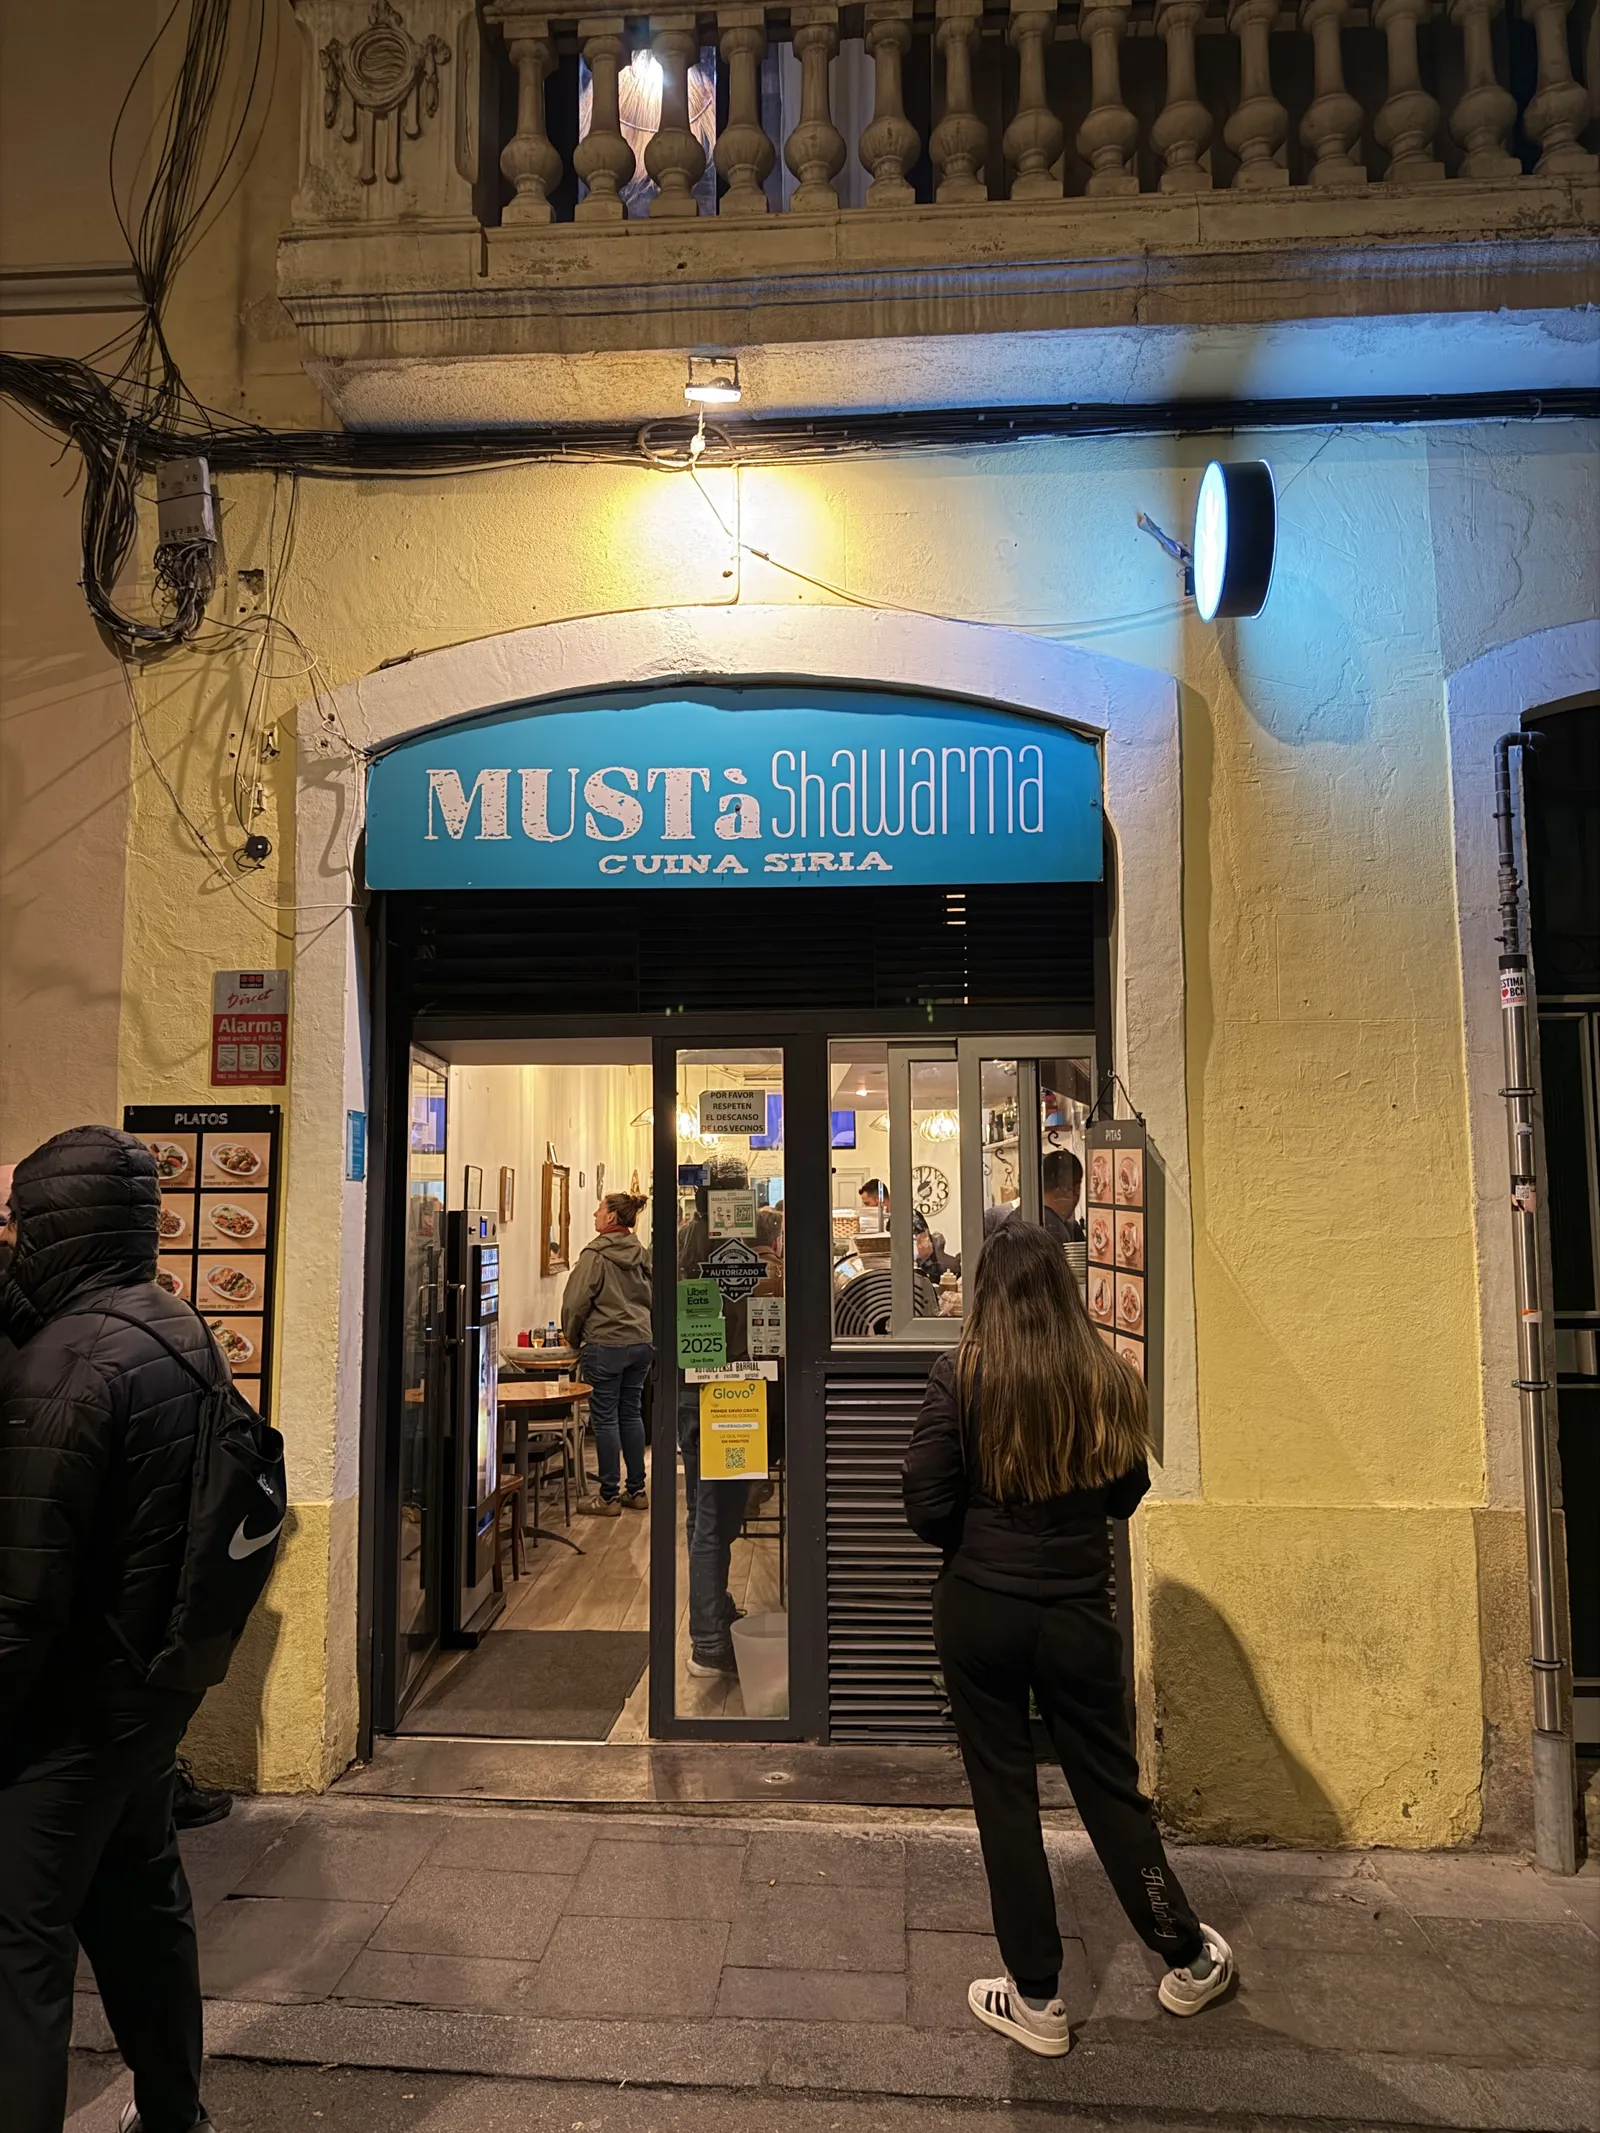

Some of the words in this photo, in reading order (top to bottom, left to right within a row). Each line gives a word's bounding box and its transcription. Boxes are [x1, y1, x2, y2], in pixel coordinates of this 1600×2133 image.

[424, 766, 762, 843] MUSTà
[771, 745, 1044, 838] Shawarma
[599, 854, 748, 874] CUINA
[764, 851, 893, 872] SIRIA
[227, 988, 276, 1009] Direct
[218, 1017, 282, 1034] Alarma
[710, 1091, 727, 1099] POR
[728, 1091, 755, 1099] FAVOR
[712, 1102, 752, 1110] RESPETEN
[174, 1112, 229, 1126] PLATOS
[705, 1113, 715, 1121] EL
[716, 1113, 759, 1121] DESCANSO
[701, 1124, 713, 1132] DE
[713, 1124, 729, 1132] LOS
[729, 1124, 764, 1132] VECINOS
[1105, 1128, 1122, 1142] PITAS
[710, 1268, 759, 1277] AUTORIZADO
[686, 1287, 709, 1296] Uber
[687, 1296, 710, 1305] Eats
[681, 1337, 723, 1354] 2025
[735, 1362, 760, 1372] BARRIAL
[712, 1387, 751, 1400] Glovo
